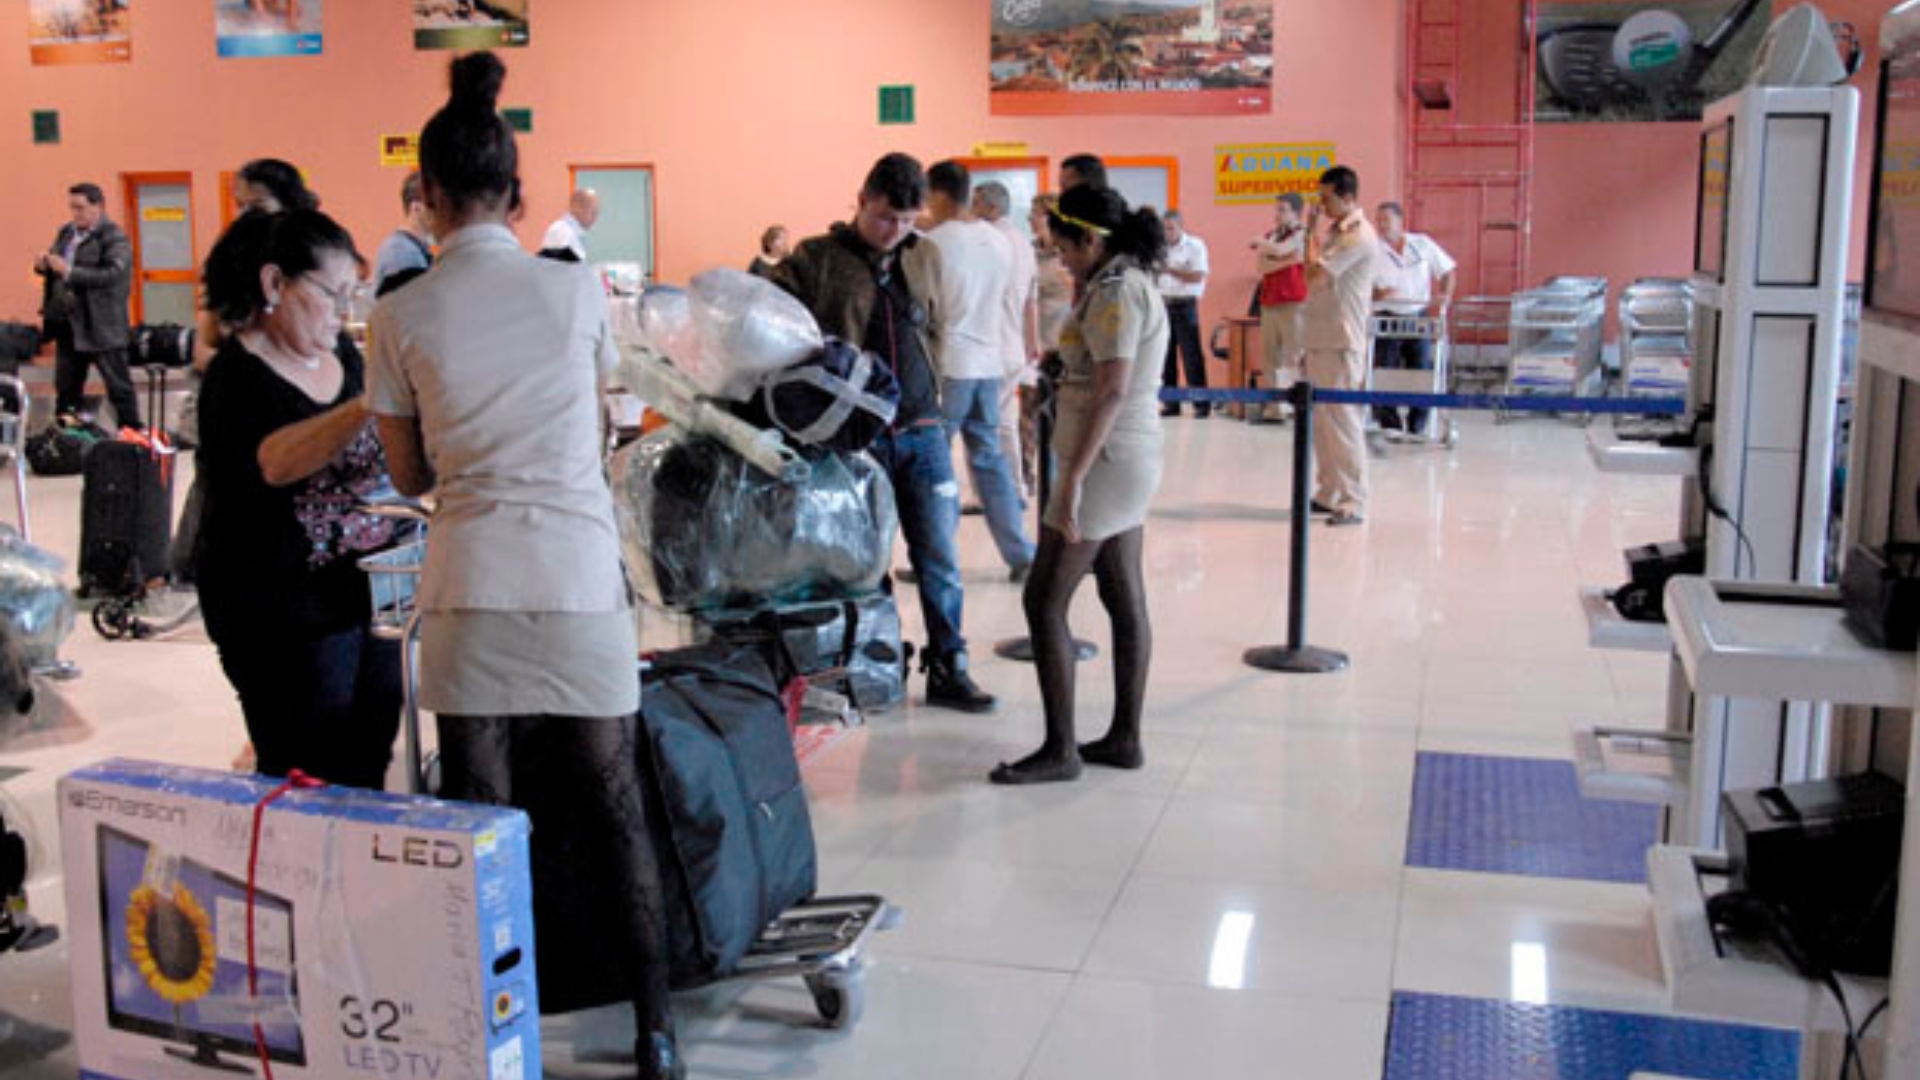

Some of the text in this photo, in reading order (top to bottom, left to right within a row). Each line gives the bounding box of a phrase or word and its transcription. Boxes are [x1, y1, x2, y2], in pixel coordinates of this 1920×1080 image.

[1220, 154, 1330, 172] ADUANA
[1220, 178, 1319, 194] SUPERVISO
[86, 789, 186, 825] Emerson
[372, 833, 463, 868] LED
[344, 1044, 441, 1078] LED TV
